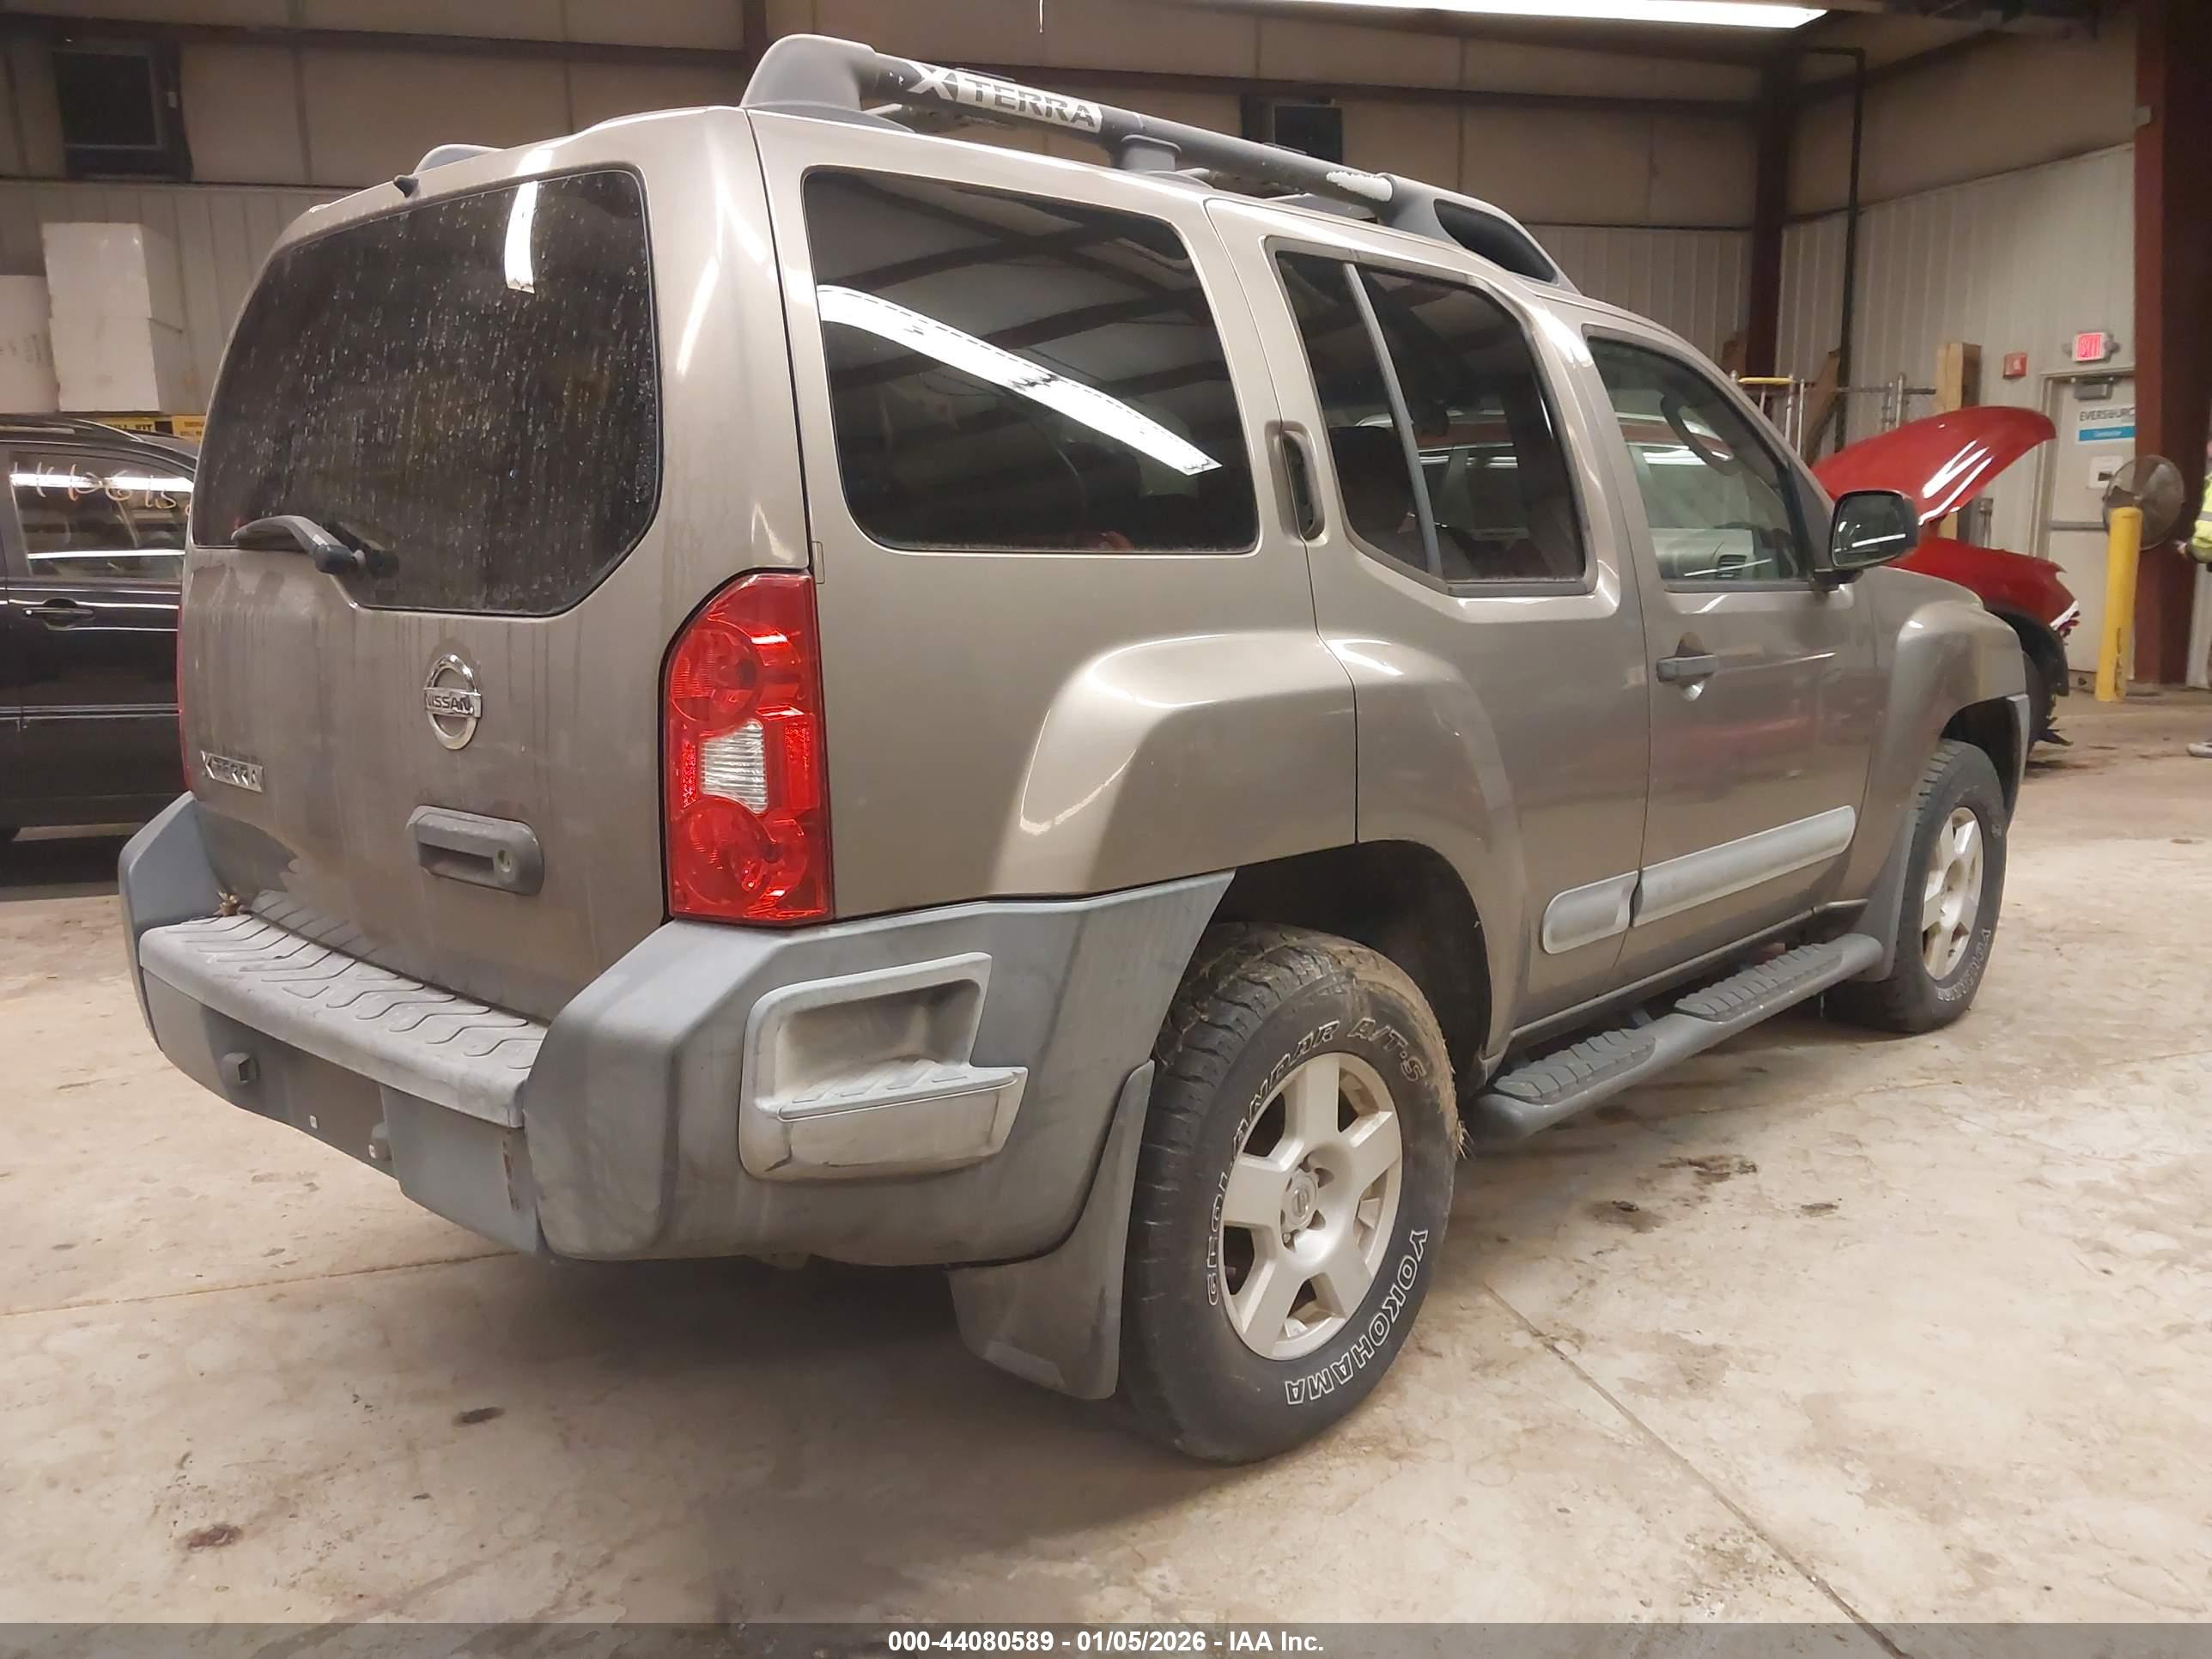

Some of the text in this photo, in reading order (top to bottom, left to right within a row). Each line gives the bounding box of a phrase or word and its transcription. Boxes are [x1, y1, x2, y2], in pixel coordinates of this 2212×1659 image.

[902, 60, 1099, 131] XTERRA
[424, 694, 473, 713] NISSAN
[1285, 1229, 1429, 1406] YOKOHAMA
